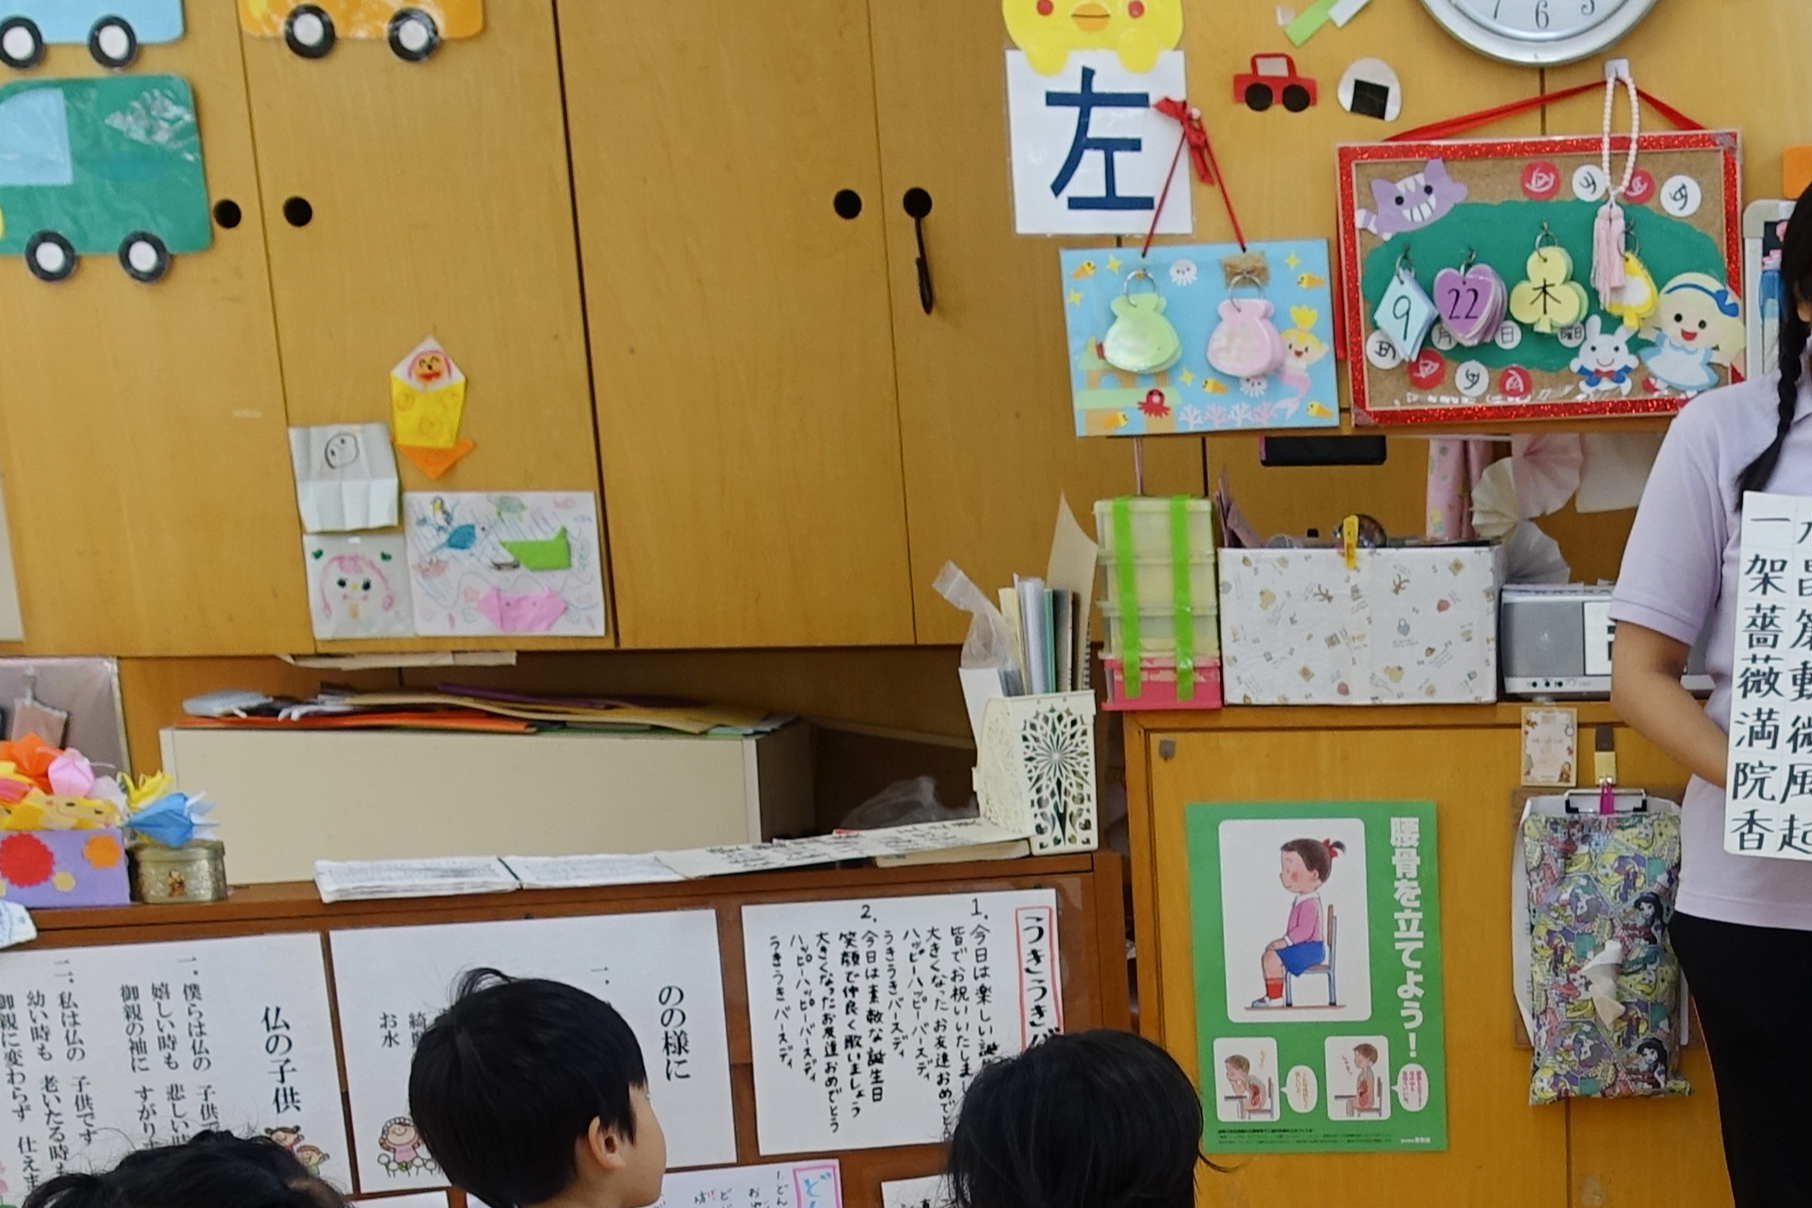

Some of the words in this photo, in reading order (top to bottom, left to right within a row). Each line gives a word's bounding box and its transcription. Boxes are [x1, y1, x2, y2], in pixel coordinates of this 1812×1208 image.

[1535, 0, 1549, 29] 6
[1045, 65, 1154, 210] 左
[1392, 295, 1413, 341] 9
[1447, 287, 1480, 320] 22
[1530, 278, 1562, 315] 木
[1501, 325, 1514, 344] 日
[26, 990, 53, 1063] 幼い時も
[120, 983, 150, 1073] 御親の袖に
[379, 1011, 401, 1049] お水
[658, 985, 691, 1082] のの様に
[261, 1006, 302, 1114] 仏の子供
[71, 1075, 97, 1146] 子供です
